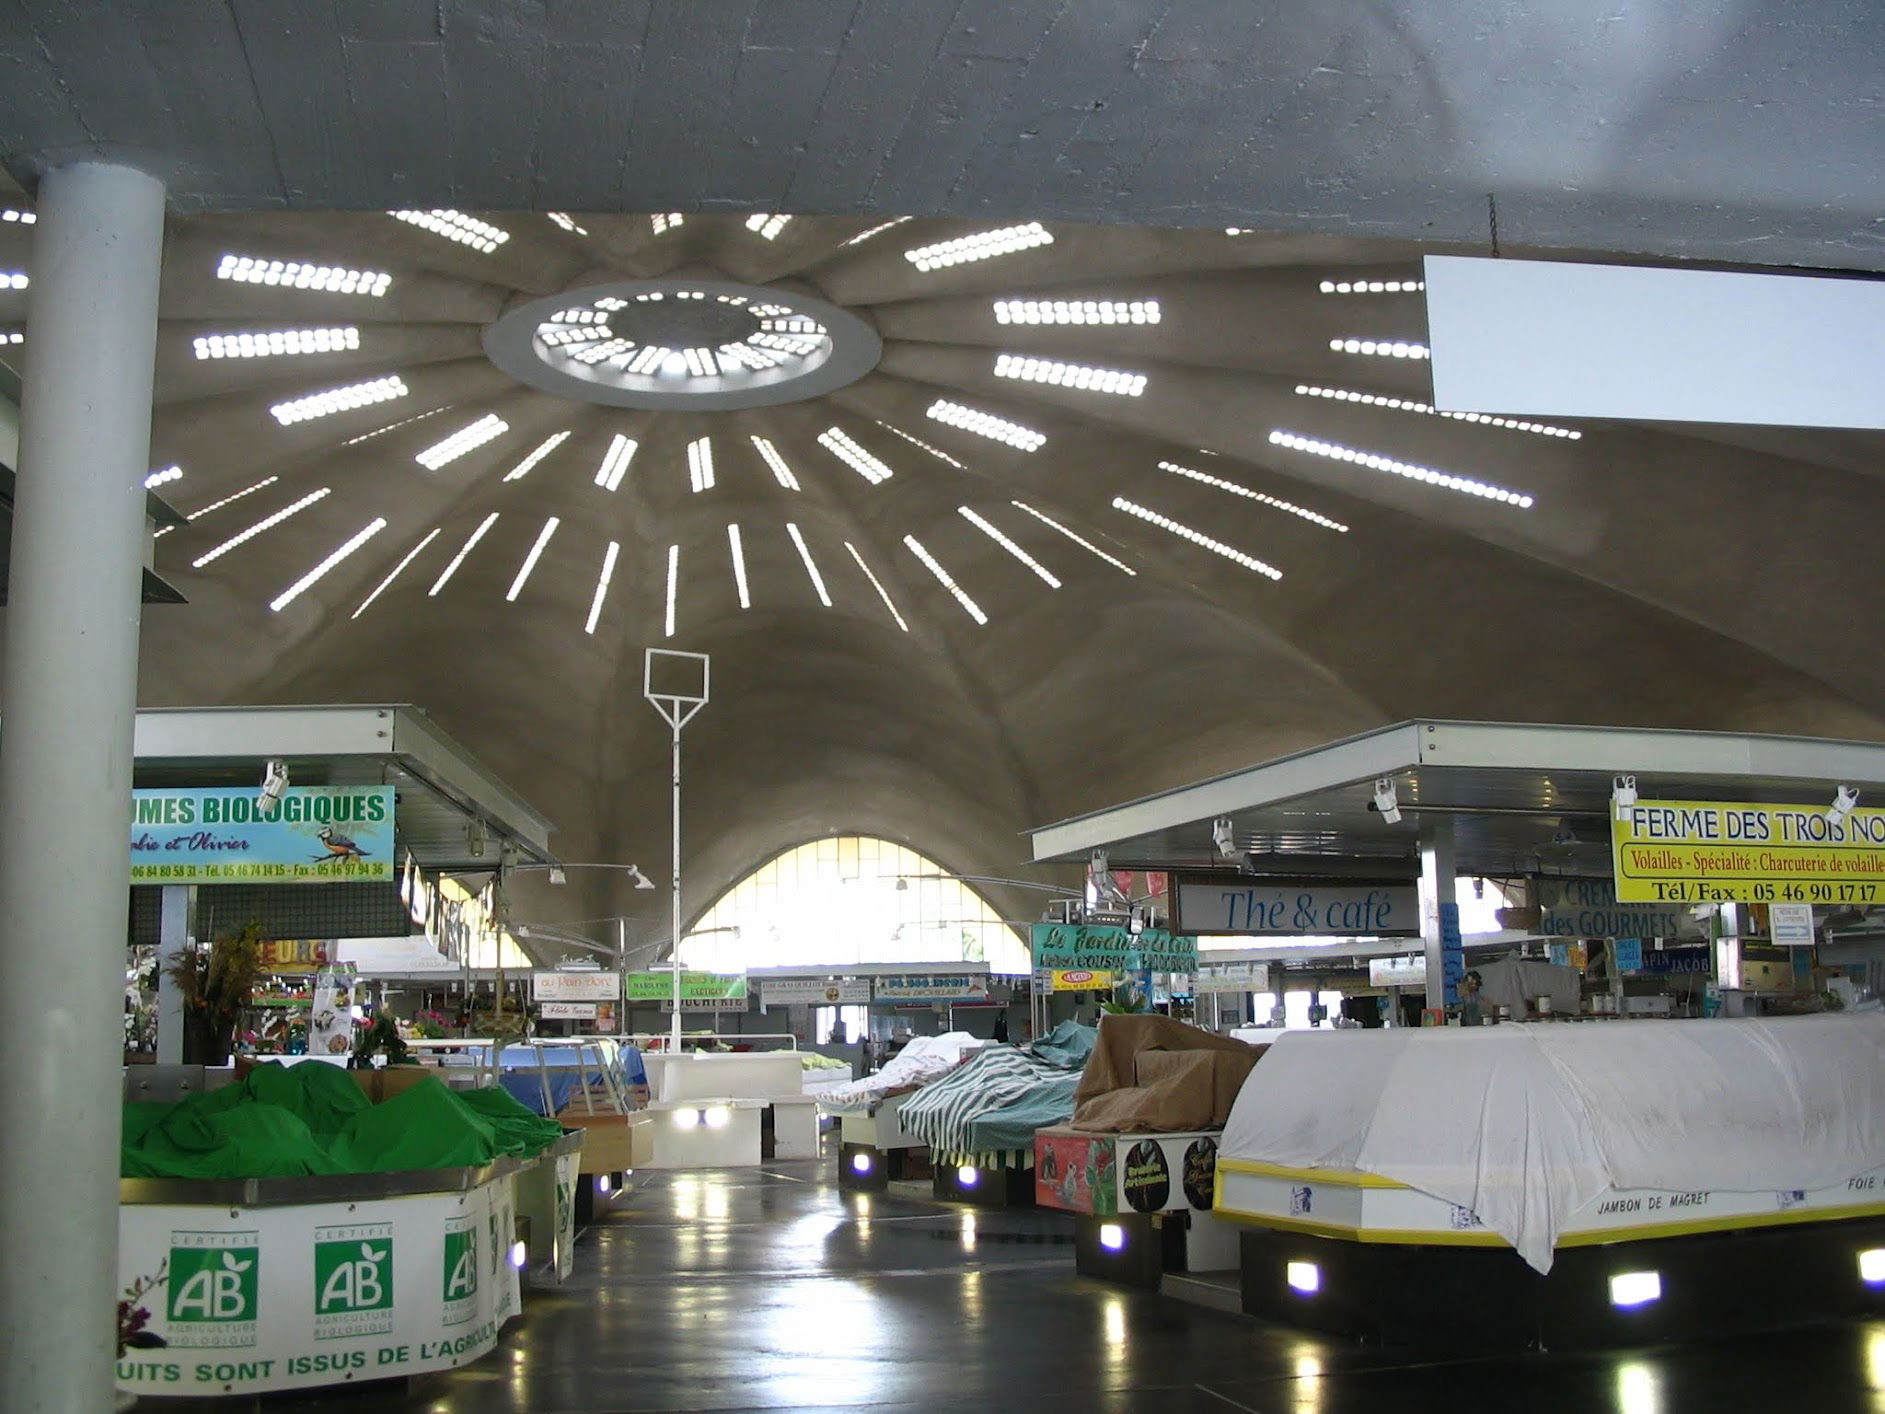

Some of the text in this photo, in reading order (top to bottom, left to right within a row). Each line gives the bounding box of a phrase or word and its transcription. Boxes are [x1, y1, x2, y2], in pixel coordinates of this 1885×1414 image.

[203, 795, 385, 824] BIOLOGIQUES
[1633, 808, 1719, 838] FERME
[1727, 810, 1769, 840] DES
[1776, 812, 1845, 842] TROIS
[165, 836, 189, 850] et
[189, 831, 249, 851] Olivier
[250, 864, 261, 877] 74
[293, 864, 309, 876] Fax
[317, 864, 329, 876] 05
[330, 864, 342, 876] 46
[344, 864, 356, 875] 97
[1631, 850, 1683, 871] Volailles
[1693, 850, 1751, 876] Spécialité
[1759, 852, 1827, 872] Charcuterie
[1829, 853, 1843, 872] de
[1652, 881, 1736, 902] Tél/Fax
[1753, 883, 1775, 901] 05
[1781, 883, 1804, 901] 46
[1810, 883, 1832, 901] 90
[1837, 883, 1855, 901] 17
[1860, 884, 1877, 902] 17
[1221, 890, 1391, 934] Thé & café
[1543, 910, 1678, 937] des GOURMETS
[1043, 926, 1065, 949] Le
[1848, 1176, 1875, 1191] FOIE
[1597, 1192, 1711, 1215] JAMBON DE MAGRET
[172, 1268, 246, 1319] AB
[321, 1260, 383, 1310] AB
[314, 1322, 393, 1337] BIOLOGIQUE
[315, 1310, 393, 1325] AGRICULTURE
[116, 1362, 181, 1382] UITS
[195, 1360, 276, 1382] SONT
[288, 1350, 366, 1375] ISSUS
[377, 1345, 410, 1365] DE
